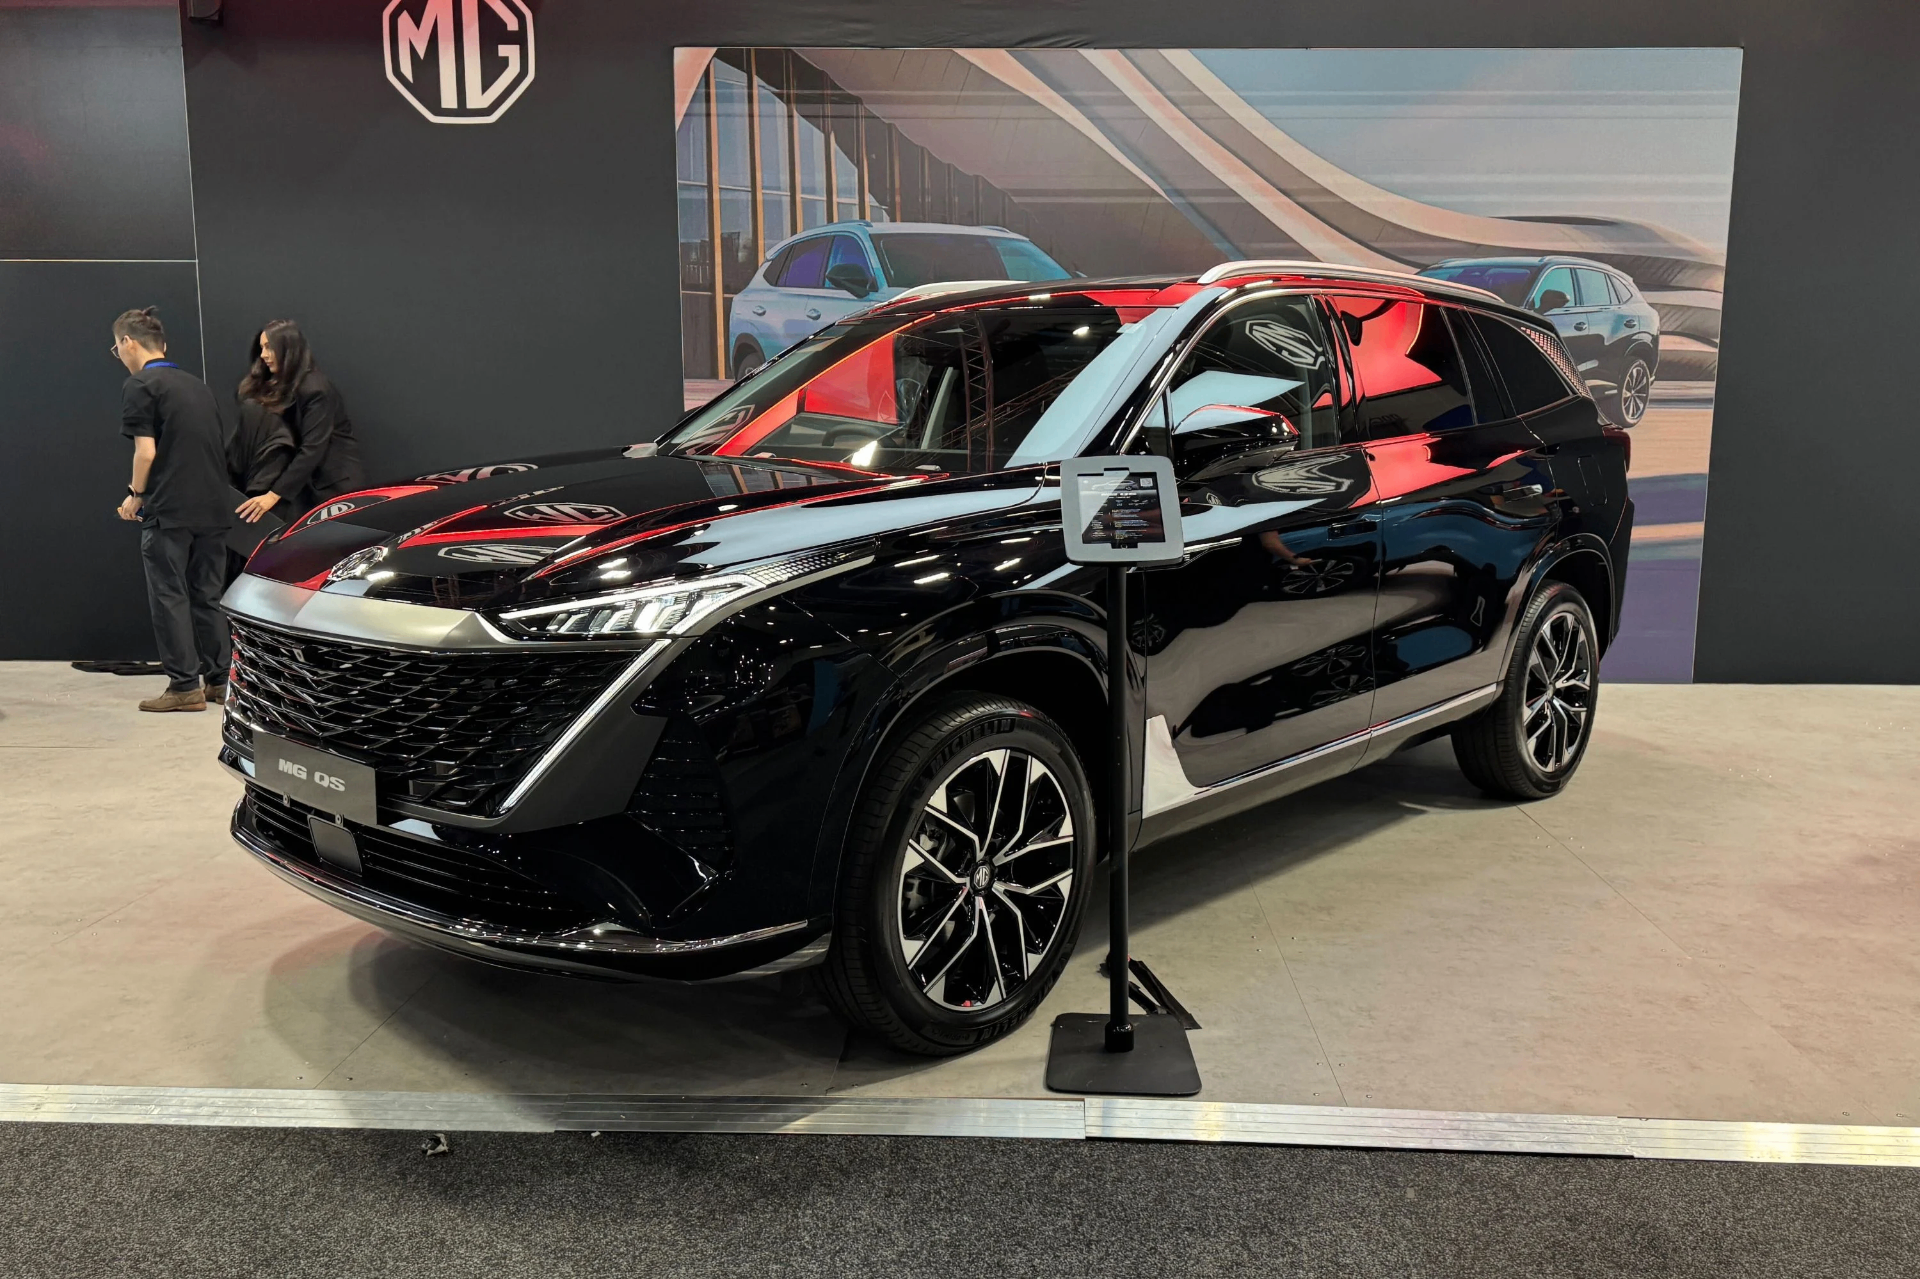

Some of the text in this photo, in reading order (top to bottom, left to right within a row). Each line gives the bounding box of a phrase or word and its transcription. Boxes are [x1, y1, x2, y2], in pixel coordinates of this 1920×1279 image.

[397, 0, 521, 109] MG
[929, 717, 1012, 775] MICHELIN
[278, 758, 346, 792] MG QS
[975, 865, 990, 888] MG
